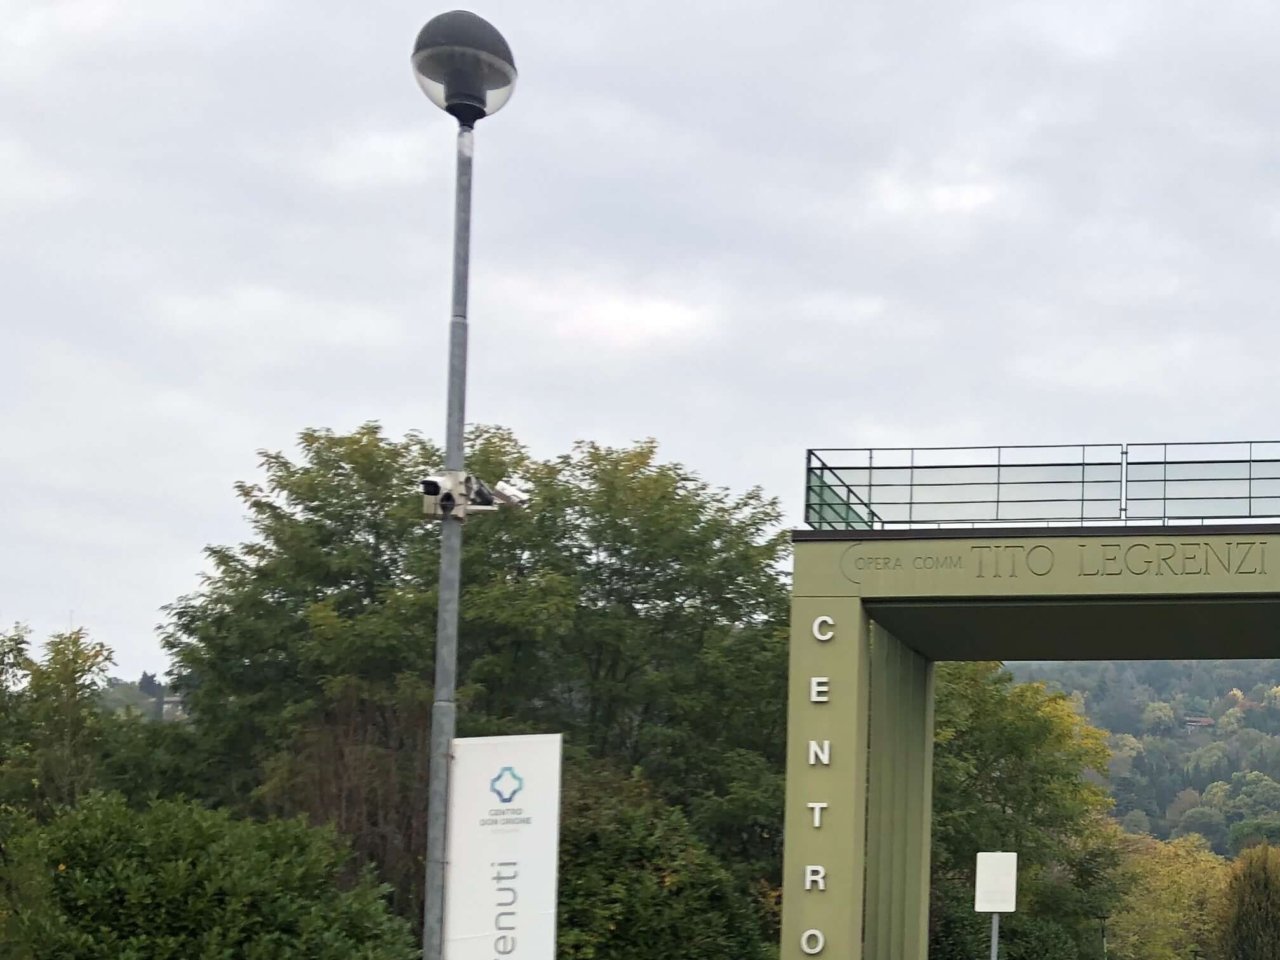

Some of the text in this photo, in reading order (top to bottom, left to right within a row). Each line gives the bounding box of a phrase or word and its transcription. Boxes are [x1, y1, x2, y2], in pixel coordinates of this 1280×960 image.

[854, 556, 902, 571] OPERA
[971, 544, 1054, 578] TITO
[1077, 541, 1268, 577] LEGRENZI
[800, 615, 836, 955] CENTRO
